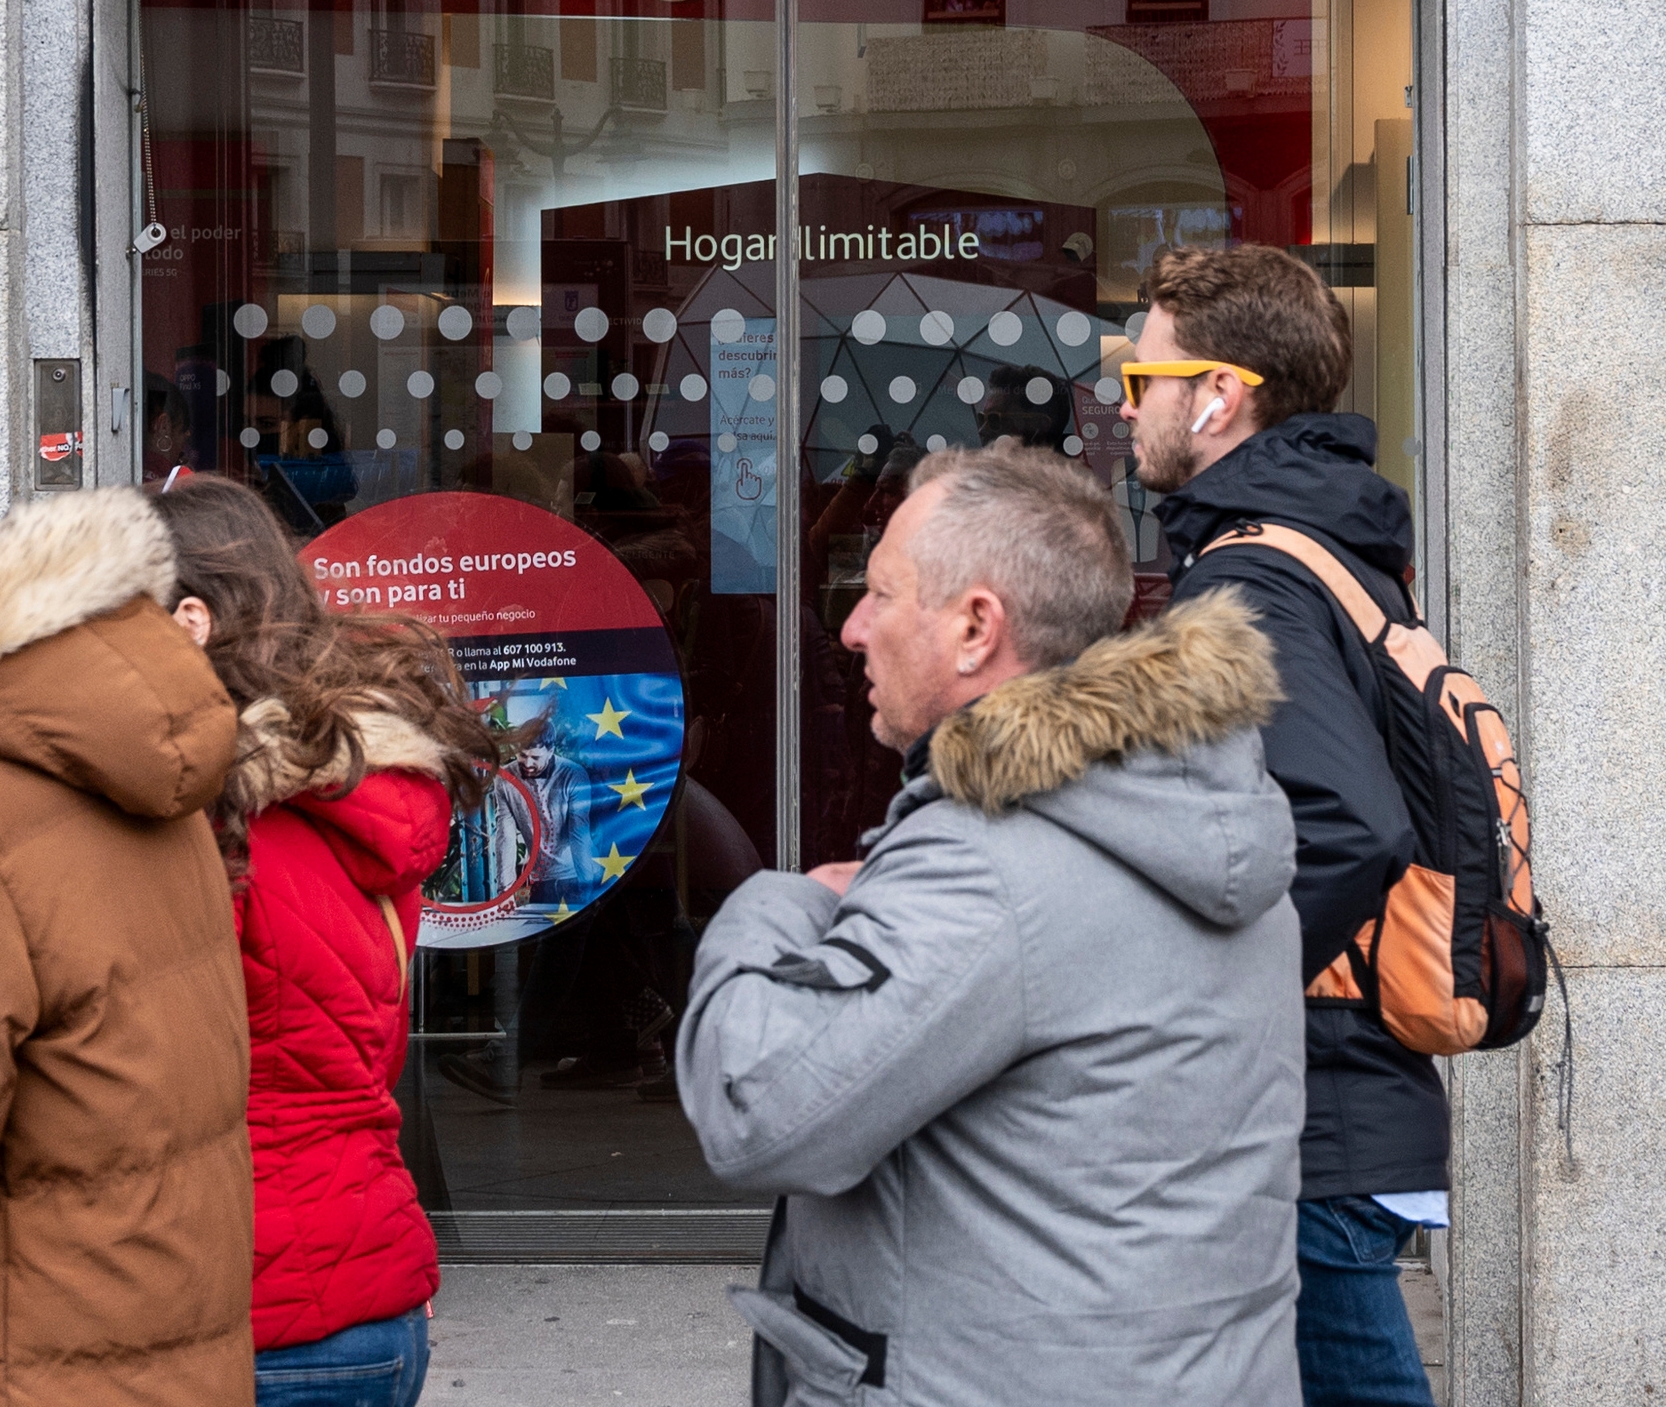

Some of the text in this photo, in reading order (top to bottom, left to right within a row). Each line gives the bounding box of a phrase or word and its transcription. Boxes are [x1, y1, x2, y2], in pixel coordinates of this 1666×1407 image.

[171, 225, 242, 243] el poder
[665, 225, 777, 271] Hogar
[719, 367, 751, 379] más?
[768, 416, 774, 426] y
[313, 549, 577, 579] Son fondos europeos
[336, 586, 381, 605] son
[387, 582, 442, 608] para
[448, 578, 466, 599] ti
[439, 613, 450, 623] tu
[451, 610, 495, 625] pequeño
[496, 609, 536, 623] negocio
[464, 647, 491, 657] llama
[493, 645, 502, 655] al
[503, 644, 522, 654] 607
[524, 643, 543, 653] 100
[544, 642, 566, 653] 913.
[464, 662, 477, 671] en
[478, 660, 488, 670] la
[489, 659, 510, 671] App
[526, 656, 577, 667] Vodafone
